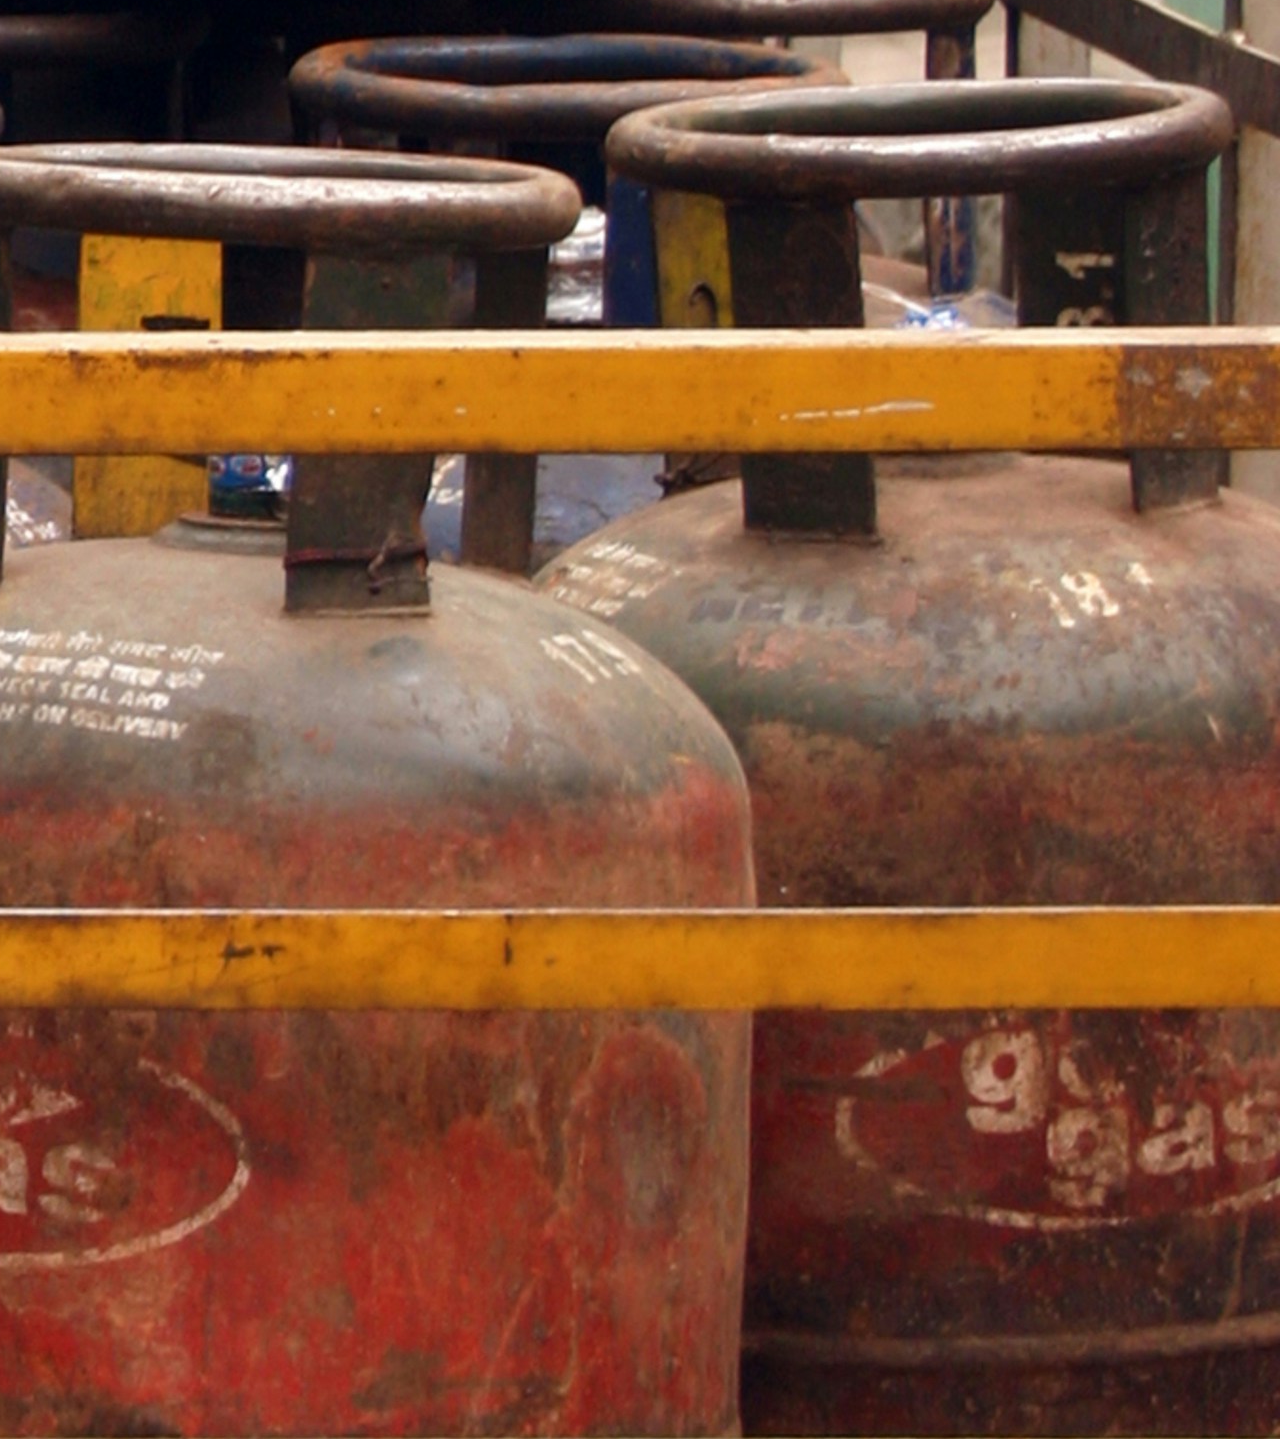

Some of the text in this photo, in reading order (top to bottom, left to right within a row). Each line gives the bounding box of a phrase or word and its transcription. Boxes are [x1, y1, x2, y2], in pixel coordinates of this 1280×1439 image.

[59, 679, 113, 704] SEAL
[32, 703, 69, 725] ON
[1044, 1089, 1280, 1209] gas
